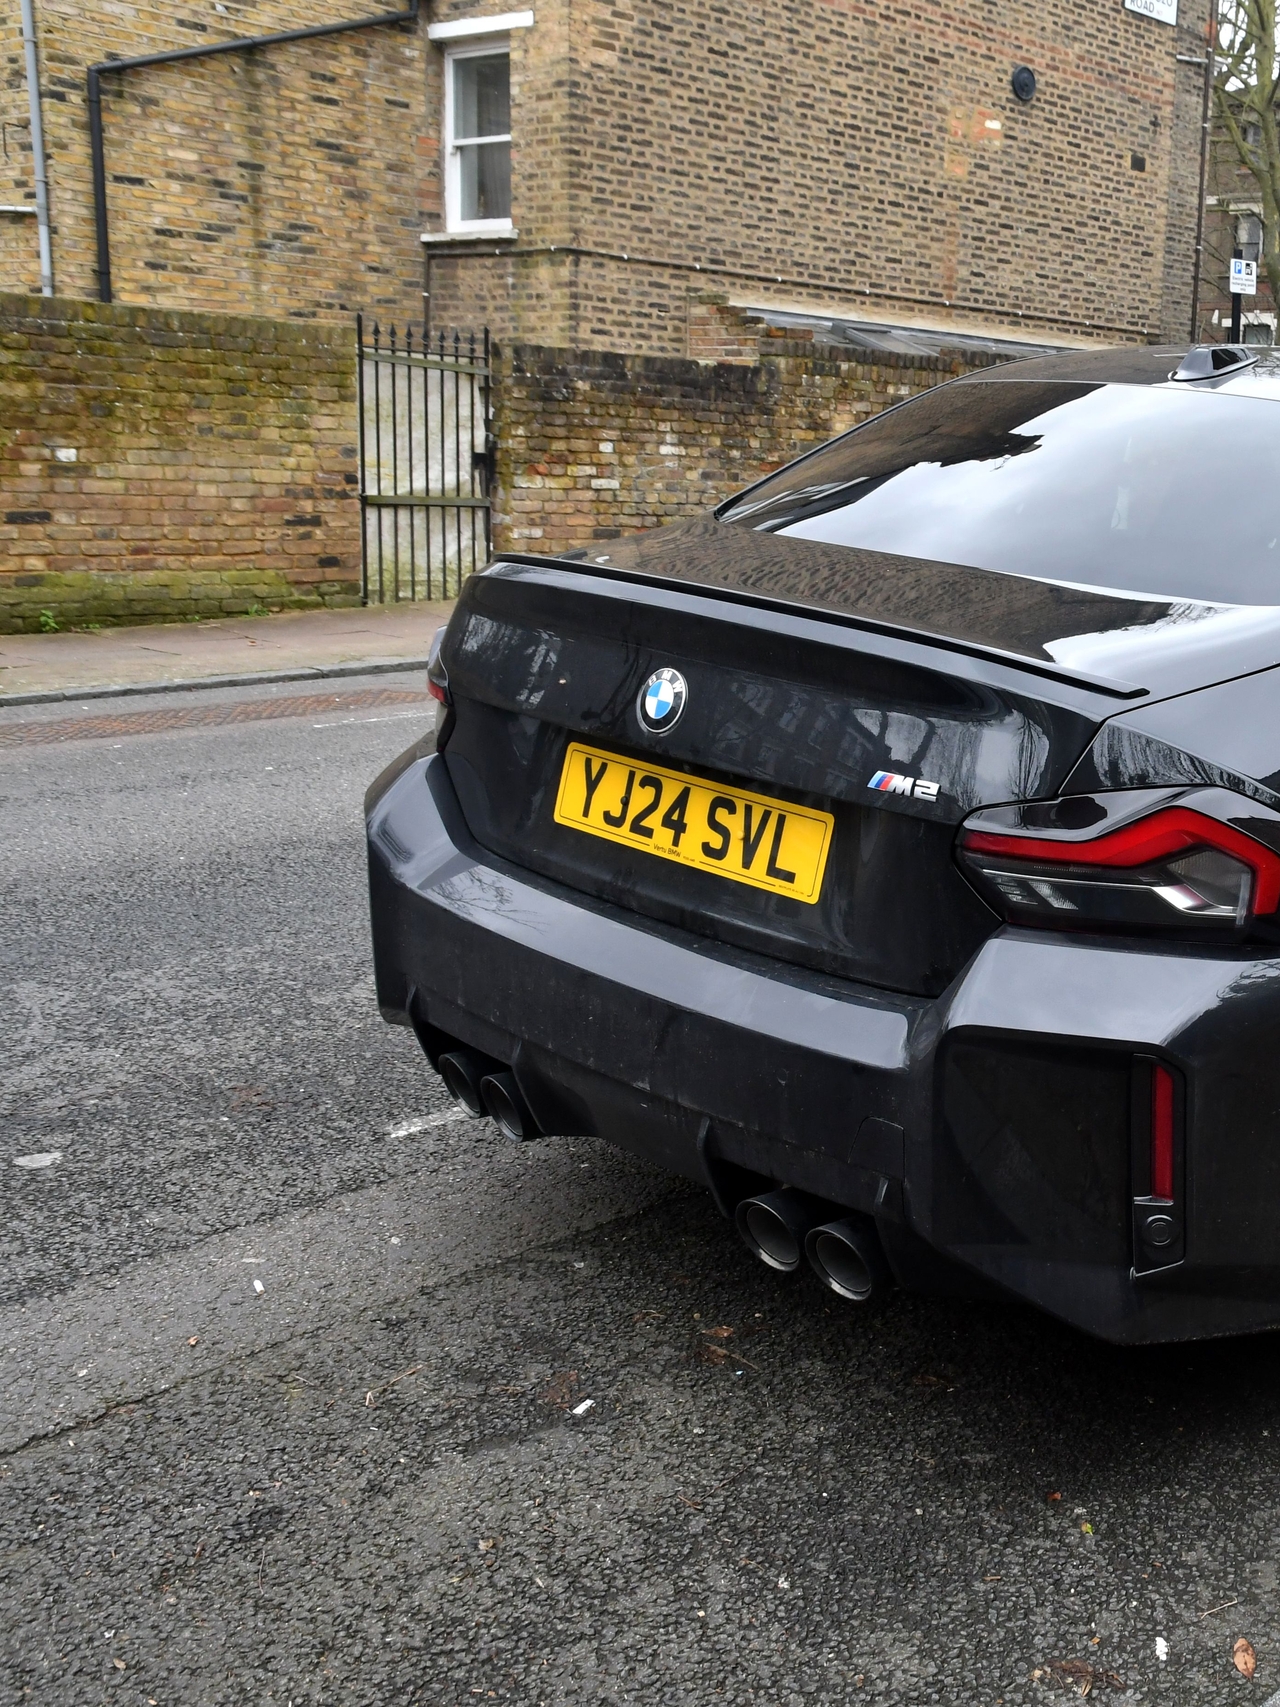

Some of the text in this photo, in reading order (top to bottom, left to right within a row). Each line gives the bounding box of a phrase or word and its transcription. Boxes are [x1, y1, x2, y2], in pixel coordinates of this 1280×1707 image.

[648, 669, 684, 694] BMW
[873, 771, 940, 802] M2
[581, 756, 797, 885] YJ24 SVL
[667, 847, 682, 858] BMW
